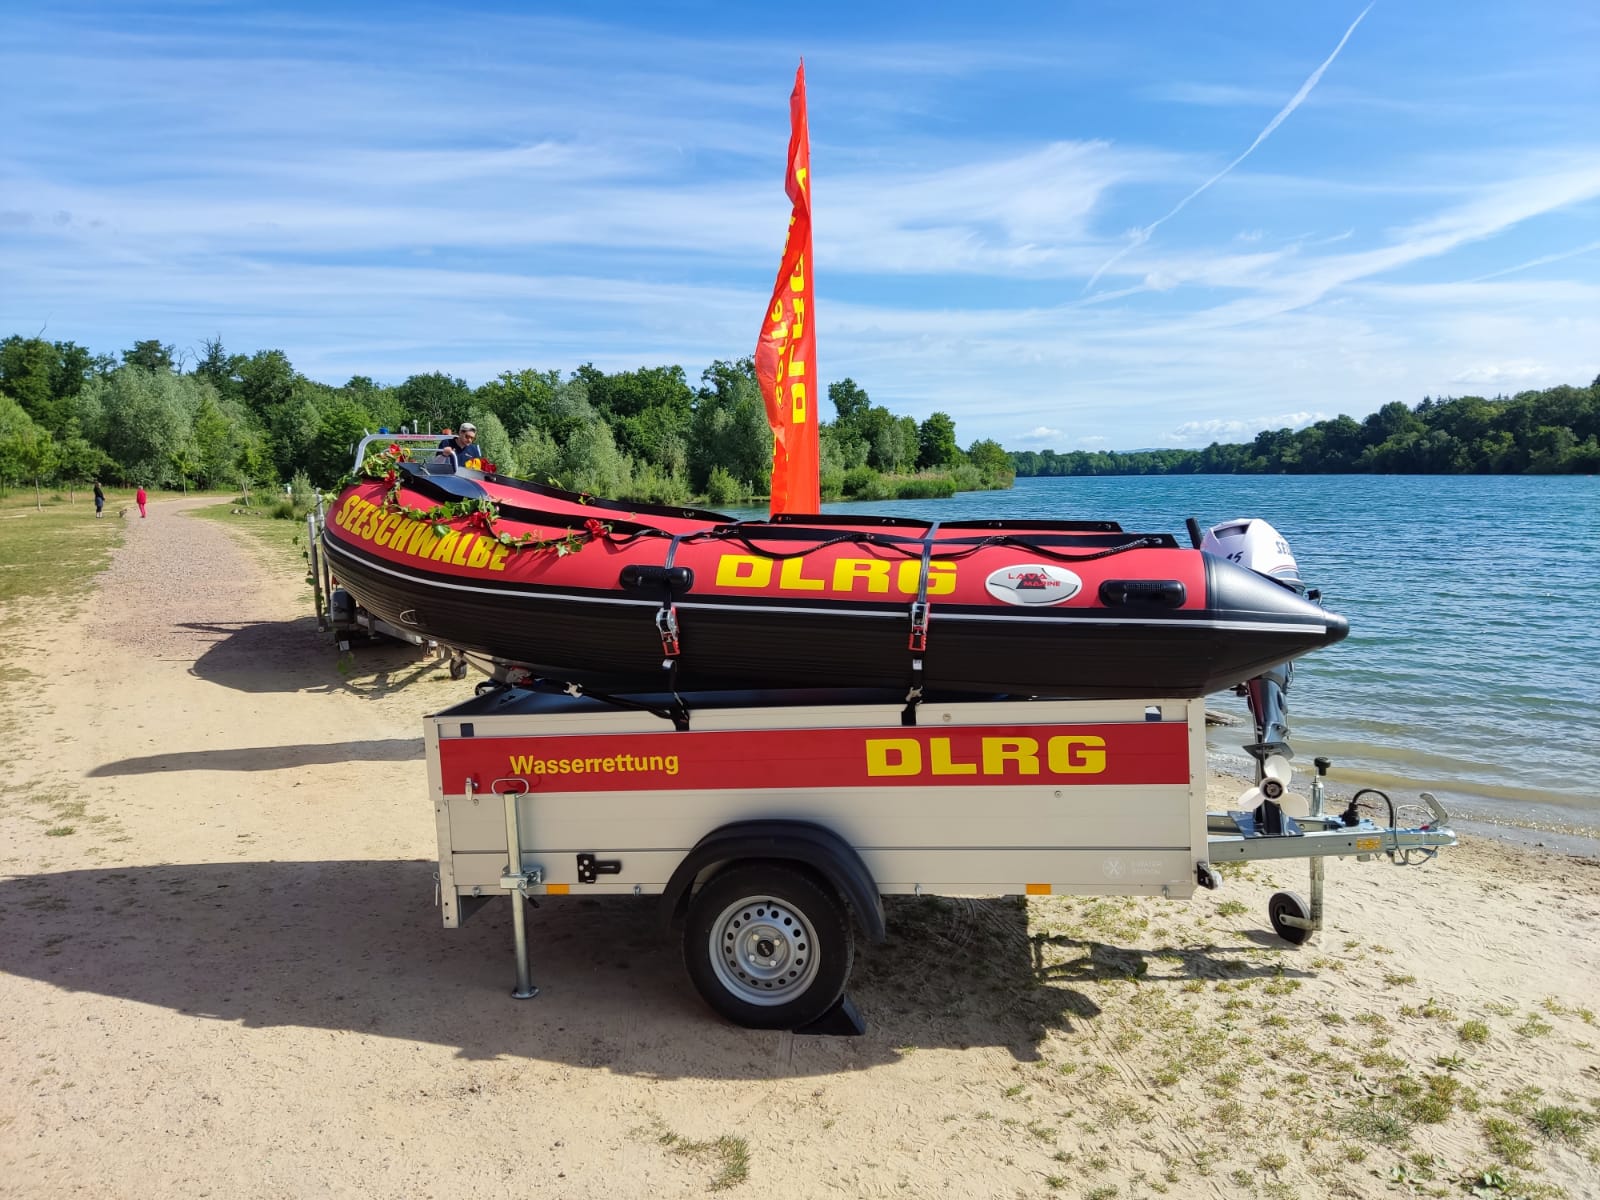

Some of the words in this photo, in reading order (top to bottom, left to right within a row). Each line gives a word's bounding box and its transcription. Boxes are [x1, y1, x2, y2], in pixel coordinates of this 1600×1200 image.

[335, 494, 510, 571] SEESCHWALBE
[715, 554, 957, 595] DLRG
[509, 754, 679, 775] Wasserrettung
[866, 735, 1106, 777] DLRG
